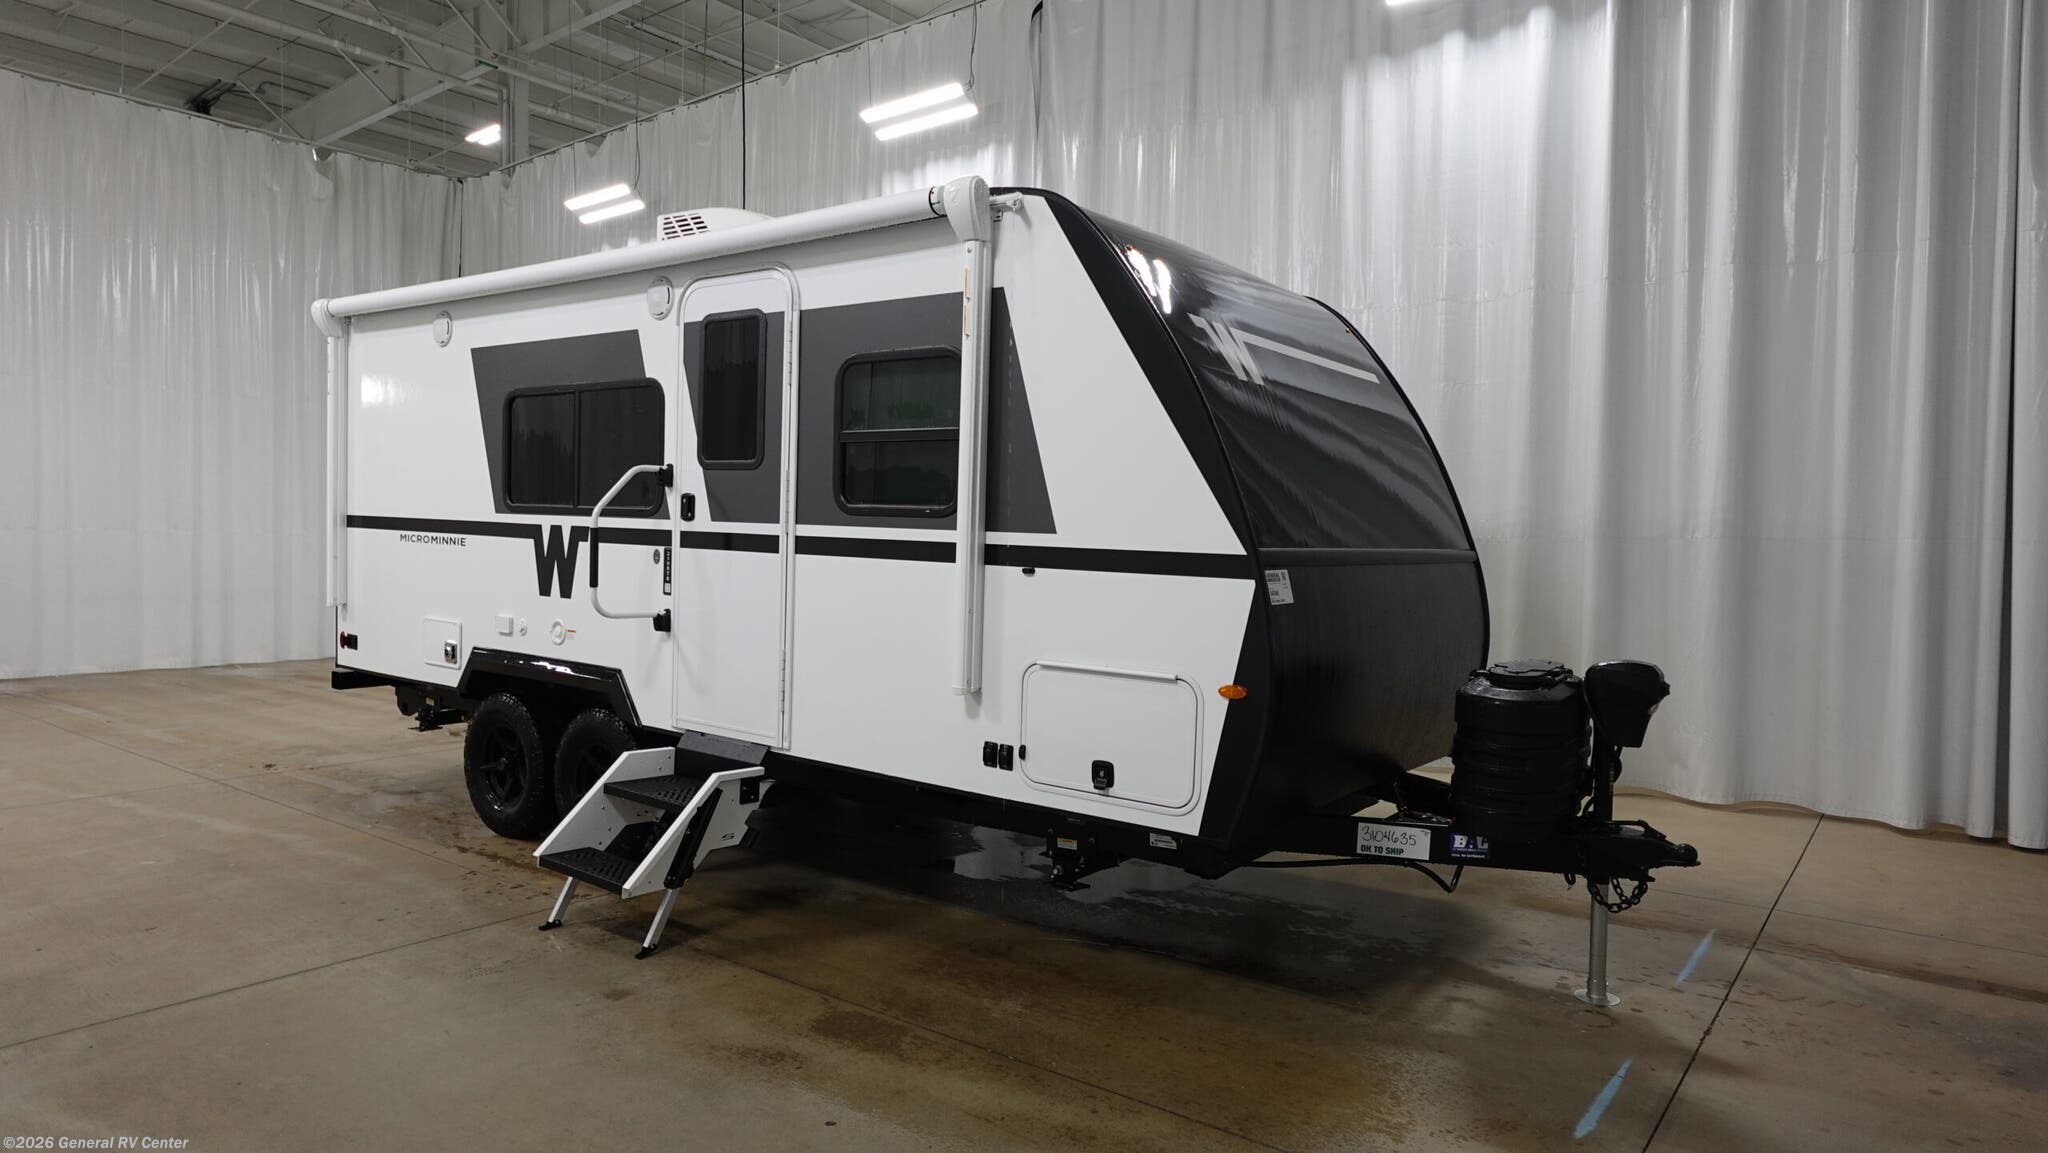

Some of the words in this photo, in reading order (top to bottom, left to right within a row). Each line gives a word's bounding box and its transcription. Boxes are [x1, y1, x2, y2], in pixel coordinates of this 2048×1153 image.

[399, 533, 467, 547] MICROMINNIE
[527, 523, 590, 599] W
[1361, 825, 1417, 846] 3104635
[1360, 844, 1372, 853] OK
[1373, 845, 1384, 854] TO
[1385, 846, 1405, 856] SHIP
